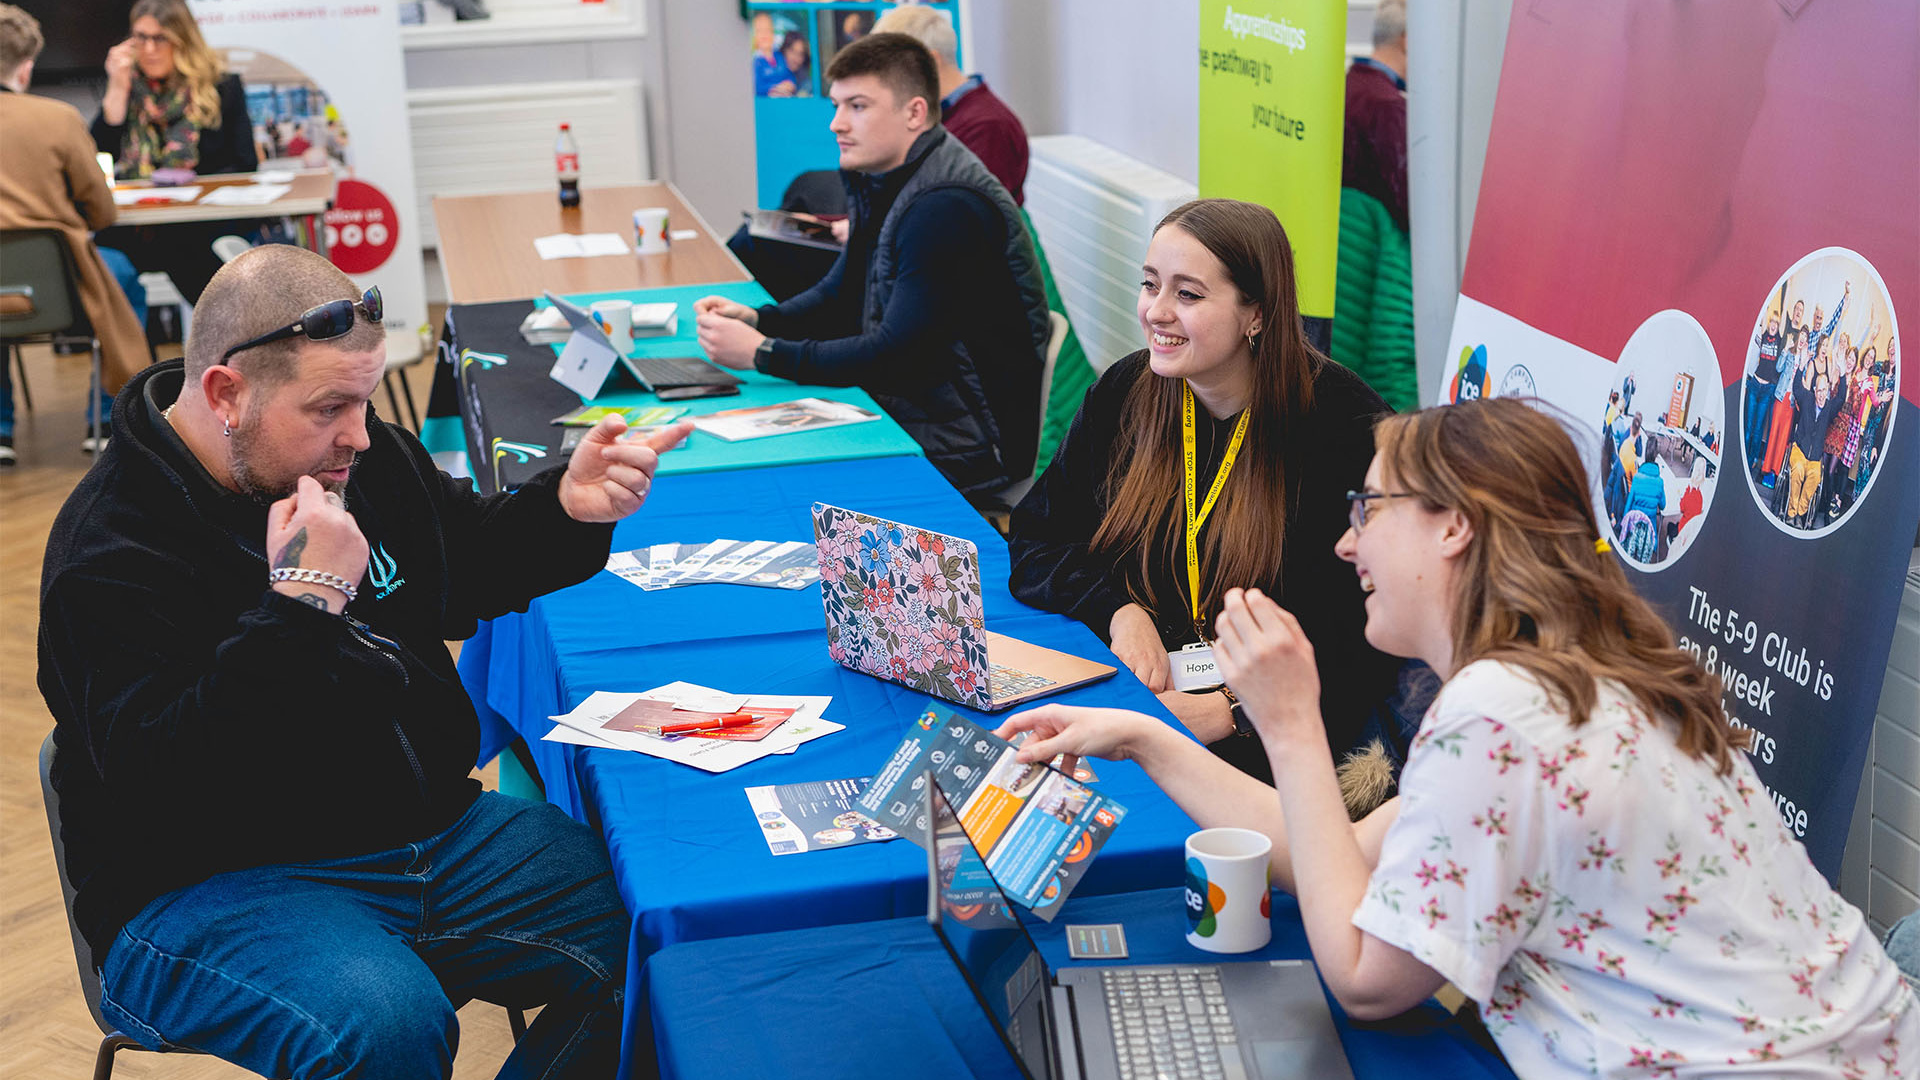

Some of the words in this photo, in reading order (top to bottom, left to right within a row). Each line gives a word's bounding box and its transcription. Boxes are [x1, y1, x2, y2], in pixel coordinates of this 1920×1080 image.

[1223, 4, 1306, 55] Apprenticeships
[1212, 48, 1260, 86] pathway
[1252, 103, 1271, 128] your
[1272, 104, 1305, 141] future
[324, 207, 363, 224] ollow
[1461, 373, 1480, 400] ice
[1186, 451, 1194, 472] STOP
[1205, 460, 1232, 504] welshice.org
[1689, 585, 1721, 635] The
[1724, 609, 1758, 654] 5-9
[1762, 632, 1812, 687] Club
[1813, 660, 1835, 701] is
[1186, 663, 1214, 673] Hope
[1679, 636, 1701, 666] an
[1705, 645, 1718, 676] 8
[1721, 661, 1775, 716] week
[1185, 887, 1204, 911] ce
